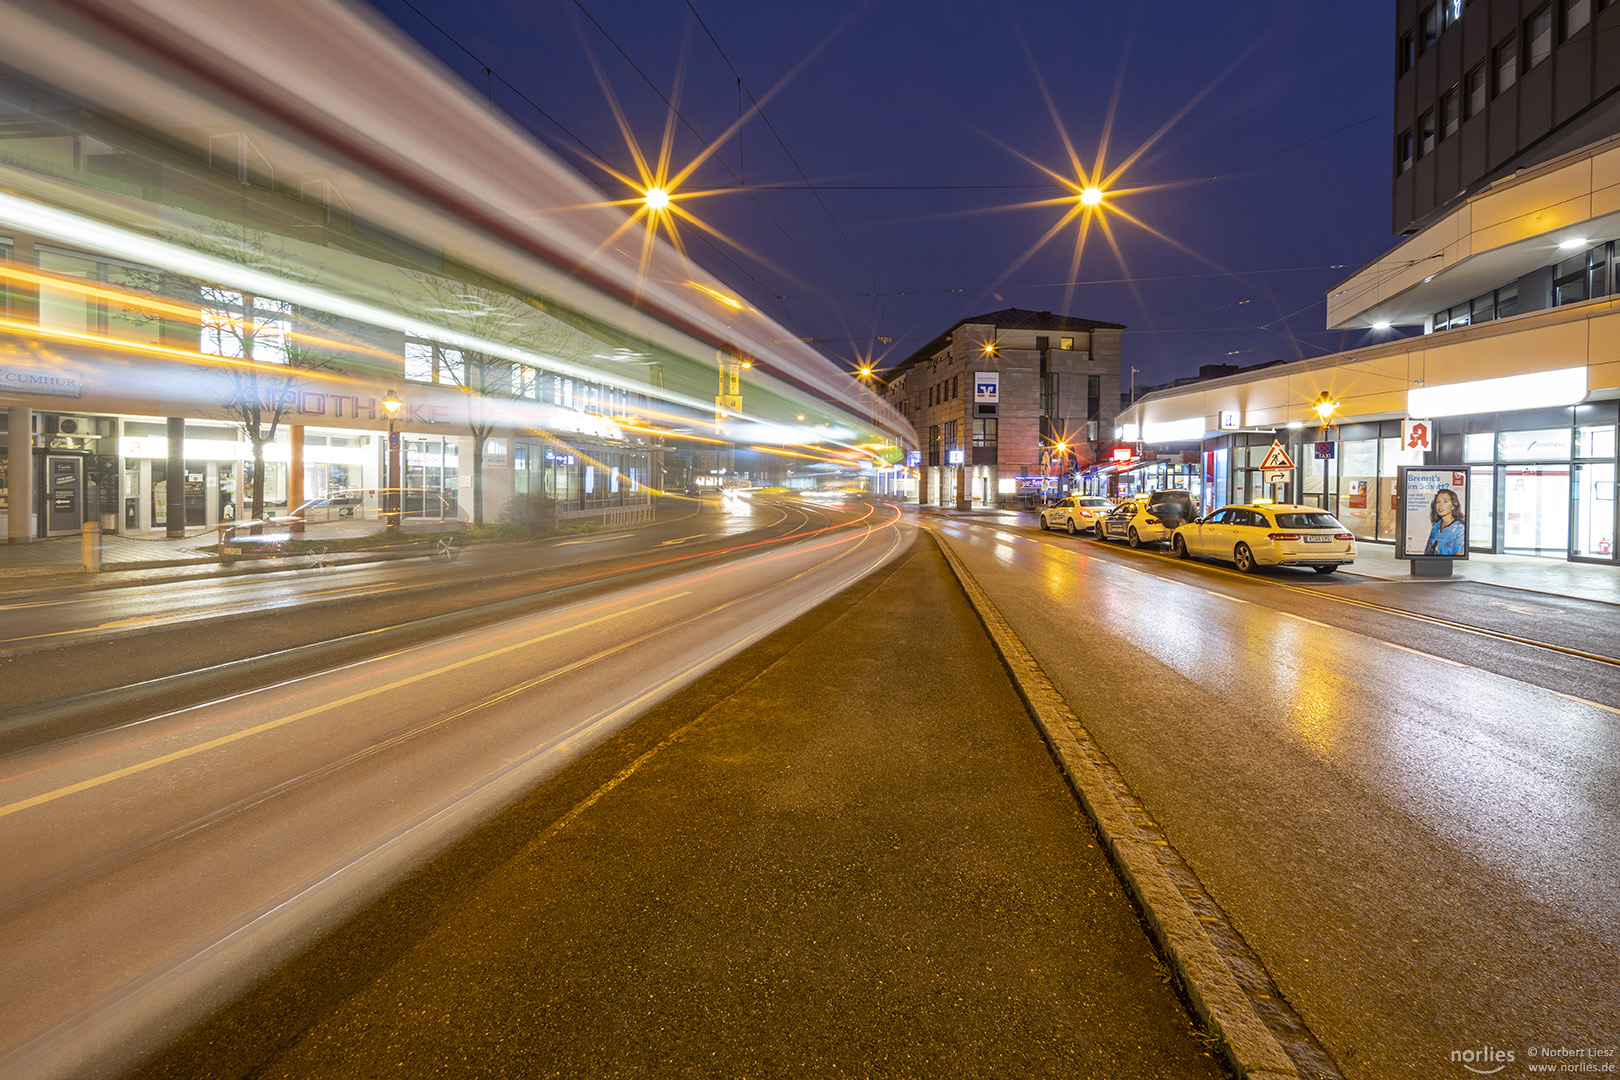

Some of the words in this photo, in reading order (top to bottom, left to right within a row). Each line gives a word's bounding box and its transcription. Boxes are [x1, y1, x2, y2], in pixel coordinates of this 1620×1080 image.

[5, 373, 77, 387] CUMHUR
[1408, 474, 1440, 482] Brennt's
[1408, 482, 1418, 490] im
[1419, 482, 1450, 490] Schritt?
